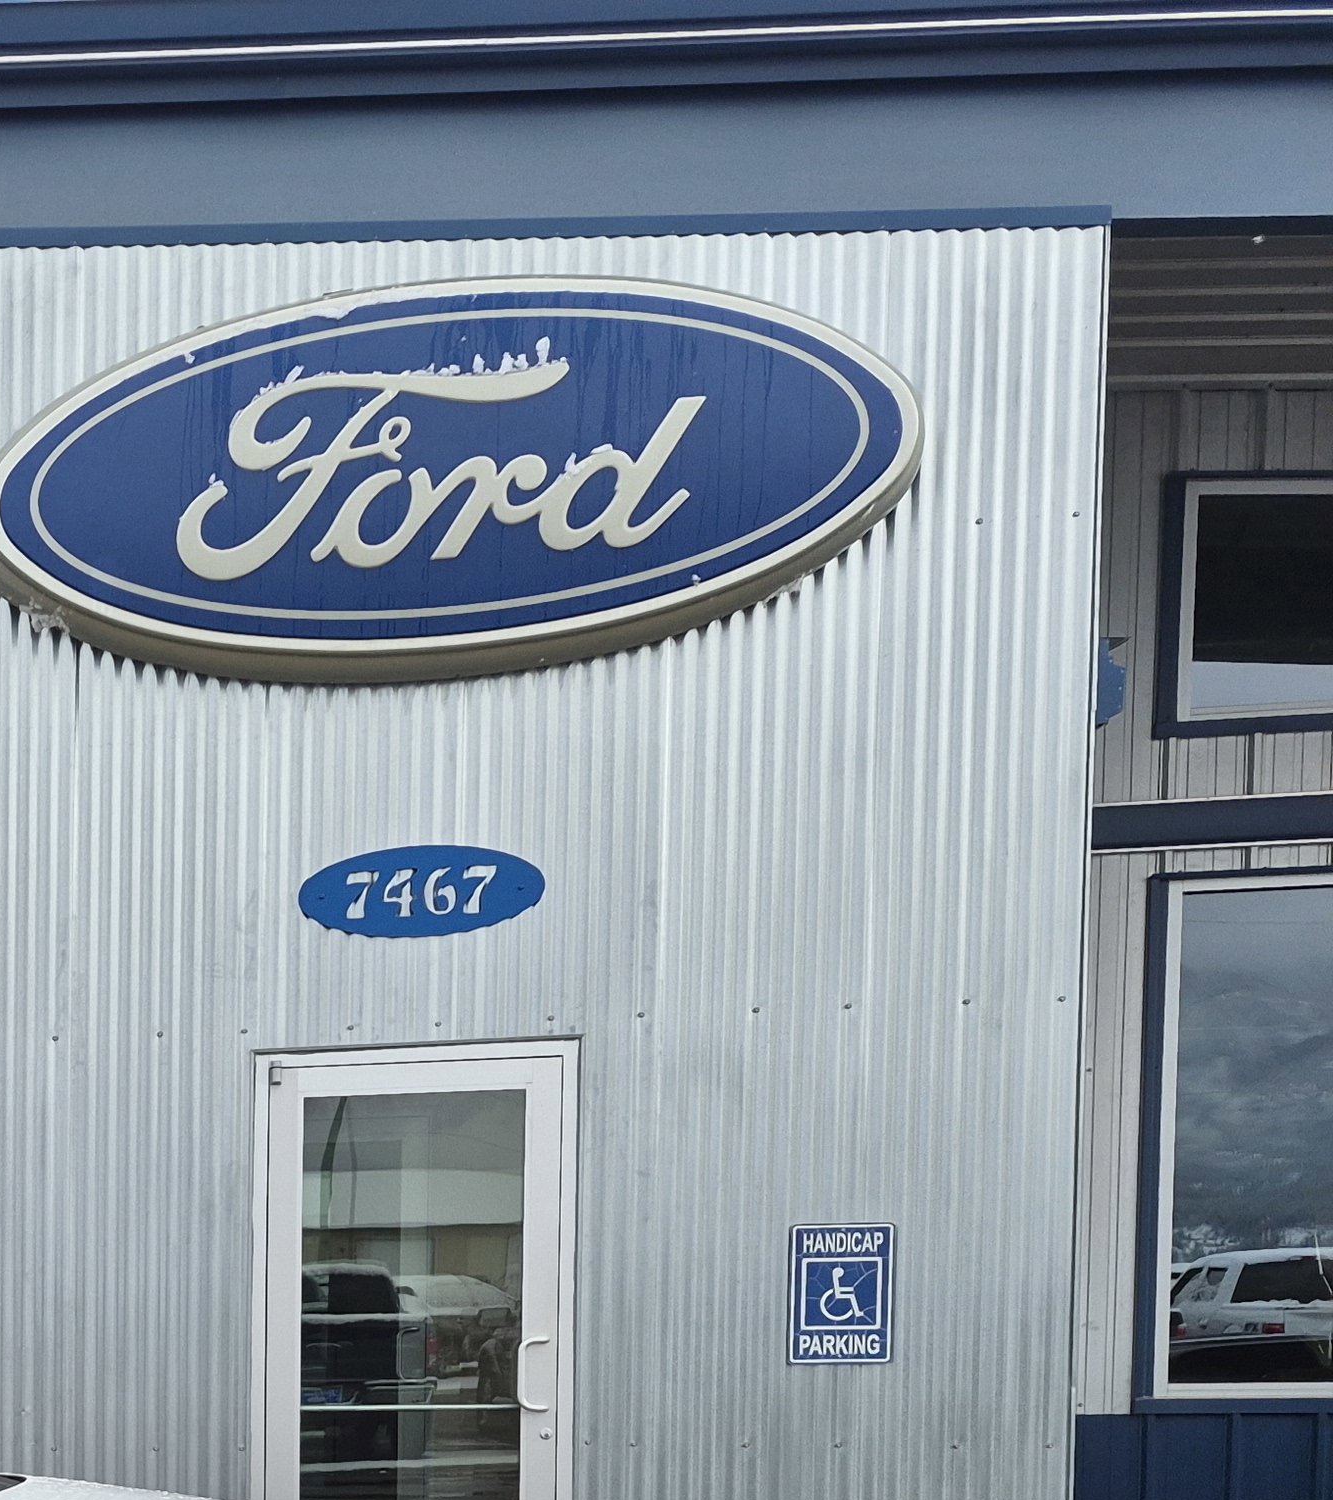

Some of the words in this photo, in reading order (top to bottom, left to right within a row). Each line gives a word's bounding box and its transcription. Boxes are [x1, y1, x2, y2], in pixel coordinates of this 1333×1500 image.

[176, 357, 707, 581] Ford
[345, 864, 498, 920] 7467
[802, 1231, 884, 1253] HANDICAP
[798, 1333, 881, 1355] PARKING
